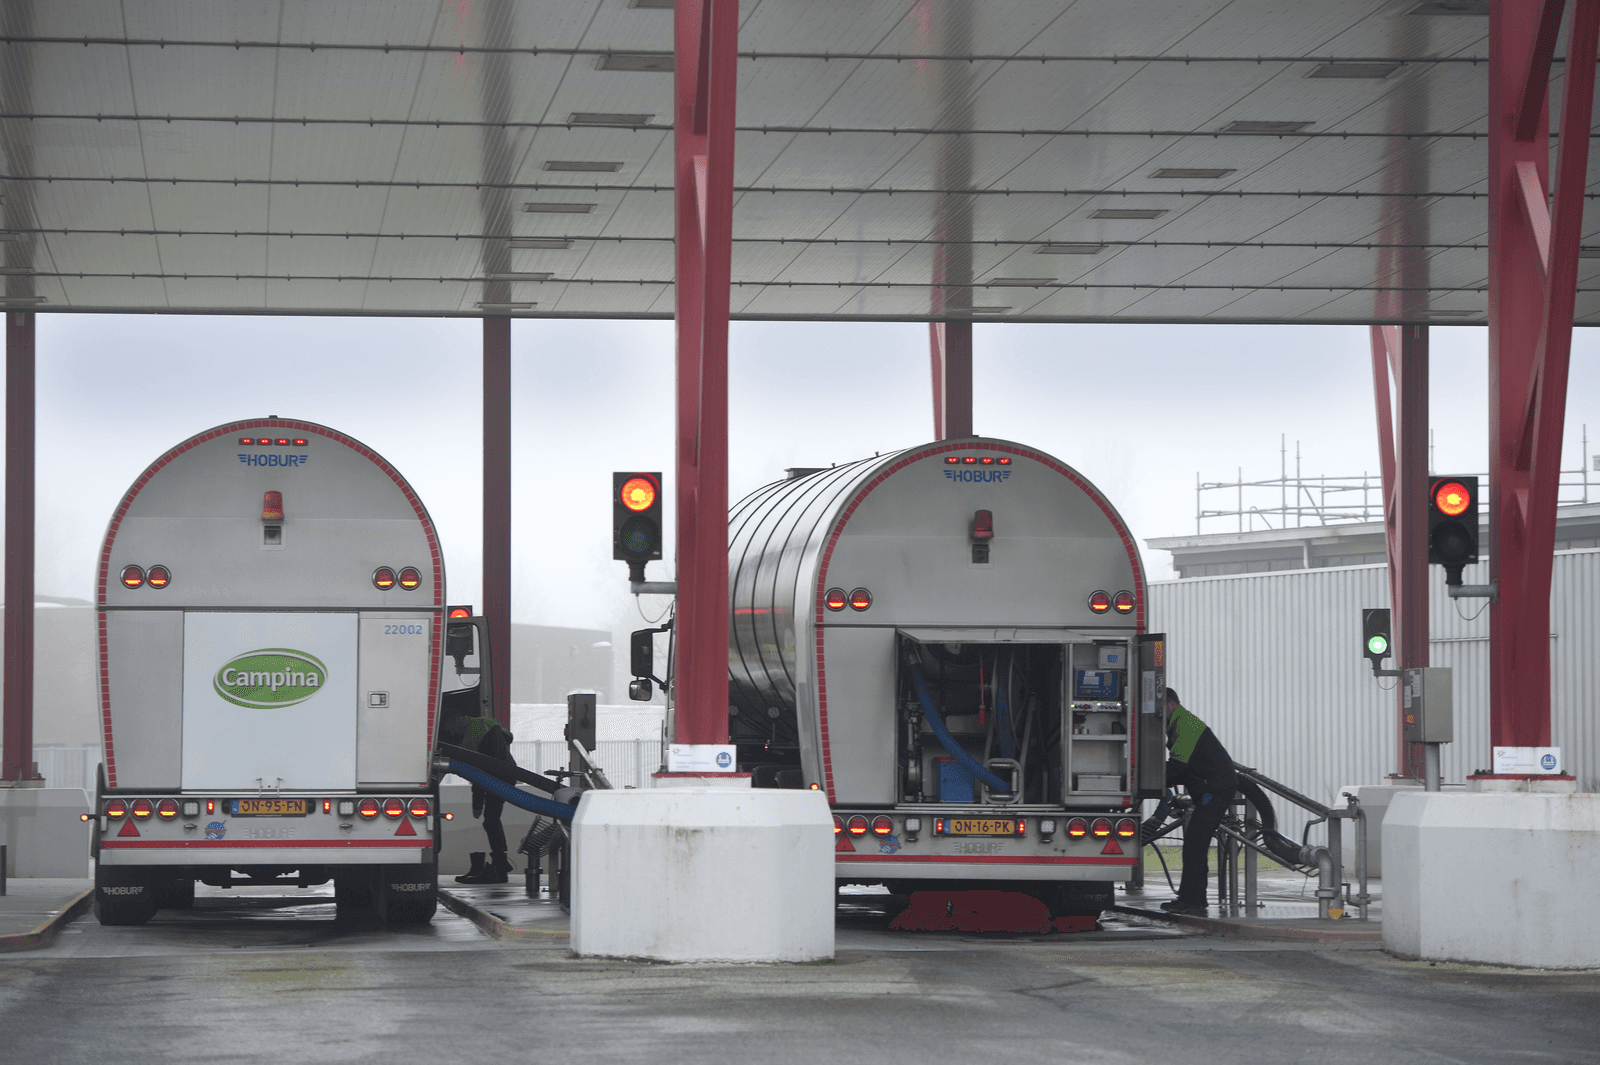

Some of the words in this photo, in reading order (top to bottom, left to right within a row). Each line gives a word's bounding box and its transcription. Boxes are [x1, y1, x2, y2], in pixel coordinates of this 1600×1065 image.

[247, 454, 299, 467] HOBUR
[953, 470, 1003, 482] HOBUR
[384, 624, 423, 635] 22002
[221, 666, 320, 692] Campina
[242, 800, 303, 812] ON-95-FN
[955, 820, 1010, 833] ON-16-PK
[249, 828, 289, 839] HOBUR
[959, 842, 998, 854] HOBUR
[108, 886, 139, 895] HOBUR
[396, 883, 426, 892] HOBUR
